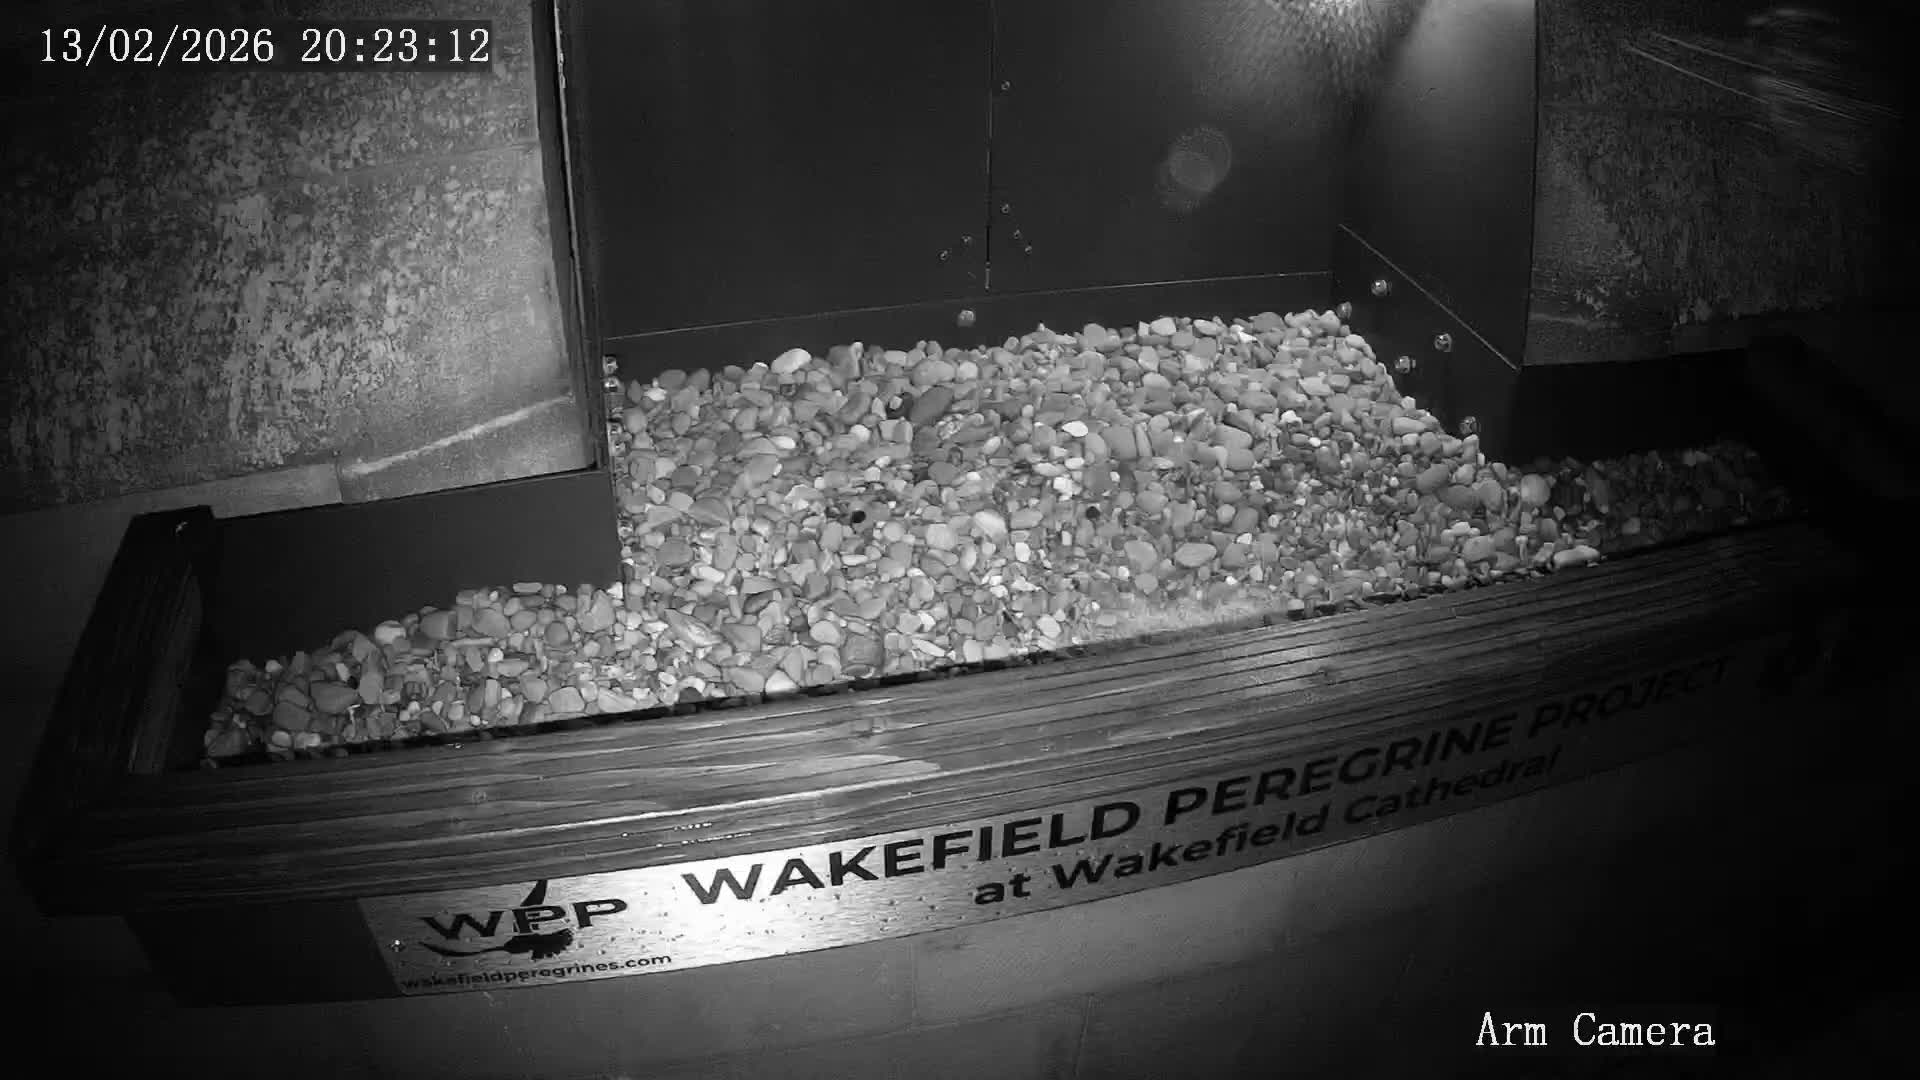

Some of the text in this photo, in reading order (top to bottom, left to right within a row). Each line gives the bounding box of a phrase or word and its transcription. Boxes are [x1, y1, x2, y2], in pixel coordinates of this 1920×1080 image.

[681, 653, 1734, 906] WAKEFIELD PEREGRINE PROJECT
[974, 744, 1563, 906] at Wakefield Cathedral
[420, 898, 628, 940] WPP
[400, 953, 672, 990] wakefieldperegrines.com
